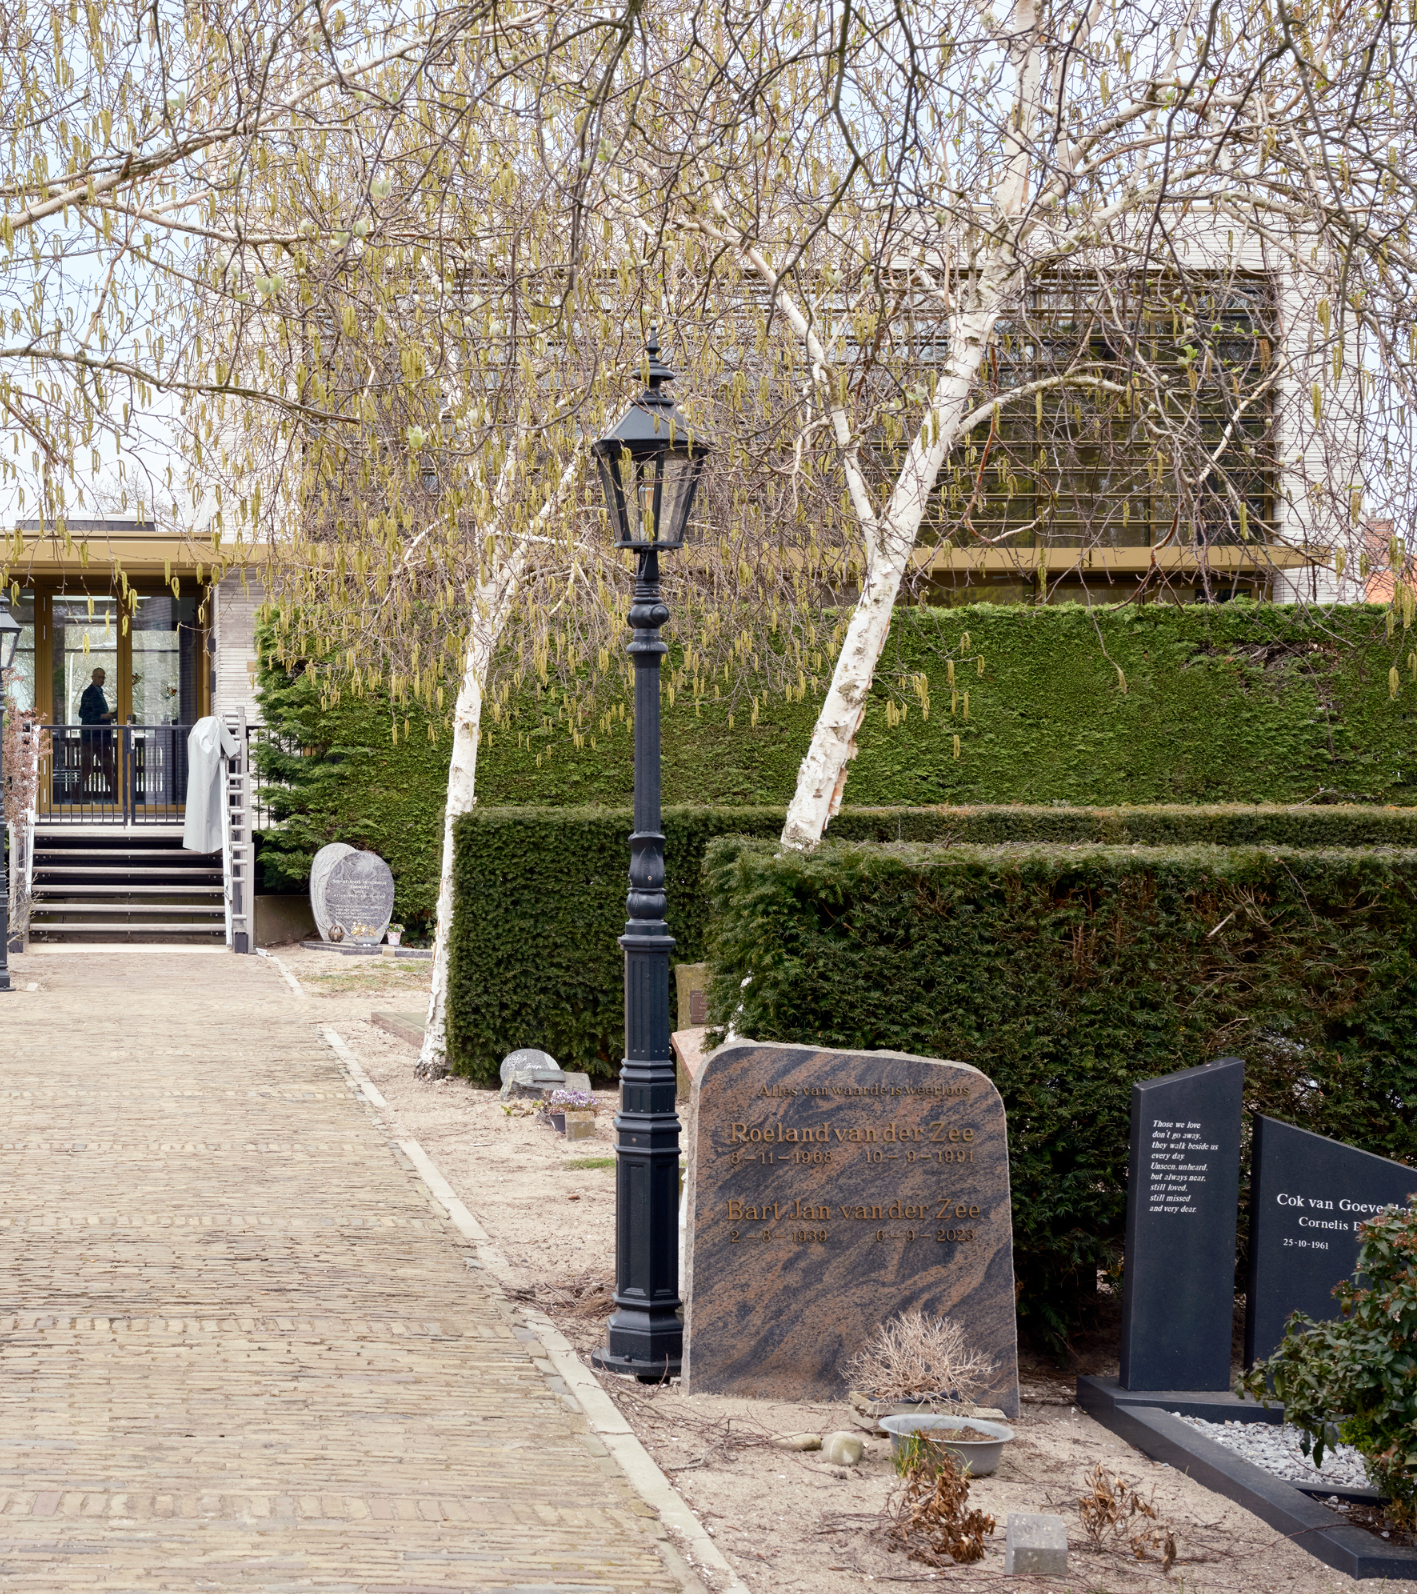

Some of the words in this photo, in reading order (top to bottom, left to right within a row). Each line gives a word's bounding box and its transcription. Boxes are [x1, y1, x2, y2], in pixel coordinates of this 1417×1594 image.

[757, 1084, 798, 1097] Alles
[802, 1086, 828, 1096] van
[831, 1083, 887, 1096] waarde
[890, 1085, 902, 1096] is
[904, 1083, 970, 1097] weerloos
[1153, 1120, 1173, 1128] Those
[1186, 1121, 1201, 1129] love
[730, 1122, 830, 1142] Roeland
[833, 1128, 878, 1142] van
[883, 1122, 924, 1142] der
[928, 1121, 975, 1142] Zee
[1171, 1133, 1181, 1141] go
[1151, 1141, 1168, 1150] they
[1187, 1142, 1209, 1150] beside
[1151, 1153, 1171, 1161] every
[1164, 1173, 1188, 1182] always
[1149, 1194, 1165, 1202] still
[1165, 1194, 1192, 1202] missed
[1276, 1193, 1305, 1207] Cok
[1308, 1198, 1334, 1210] van
[727, 1200, 781, 1220] Bart
[789, 1200, 831, 1220] Jan
[839, 1205, 884, 1220] van
[888, 1199, 929, 1220] der
[935, 1199, 981, 1219] Zee
[1164, 1206, 1179, 1214] very
[1298, 1216, 1349, 1231] Cornelis
[1283, 1238, 1329, 1250] 25-10-1961
